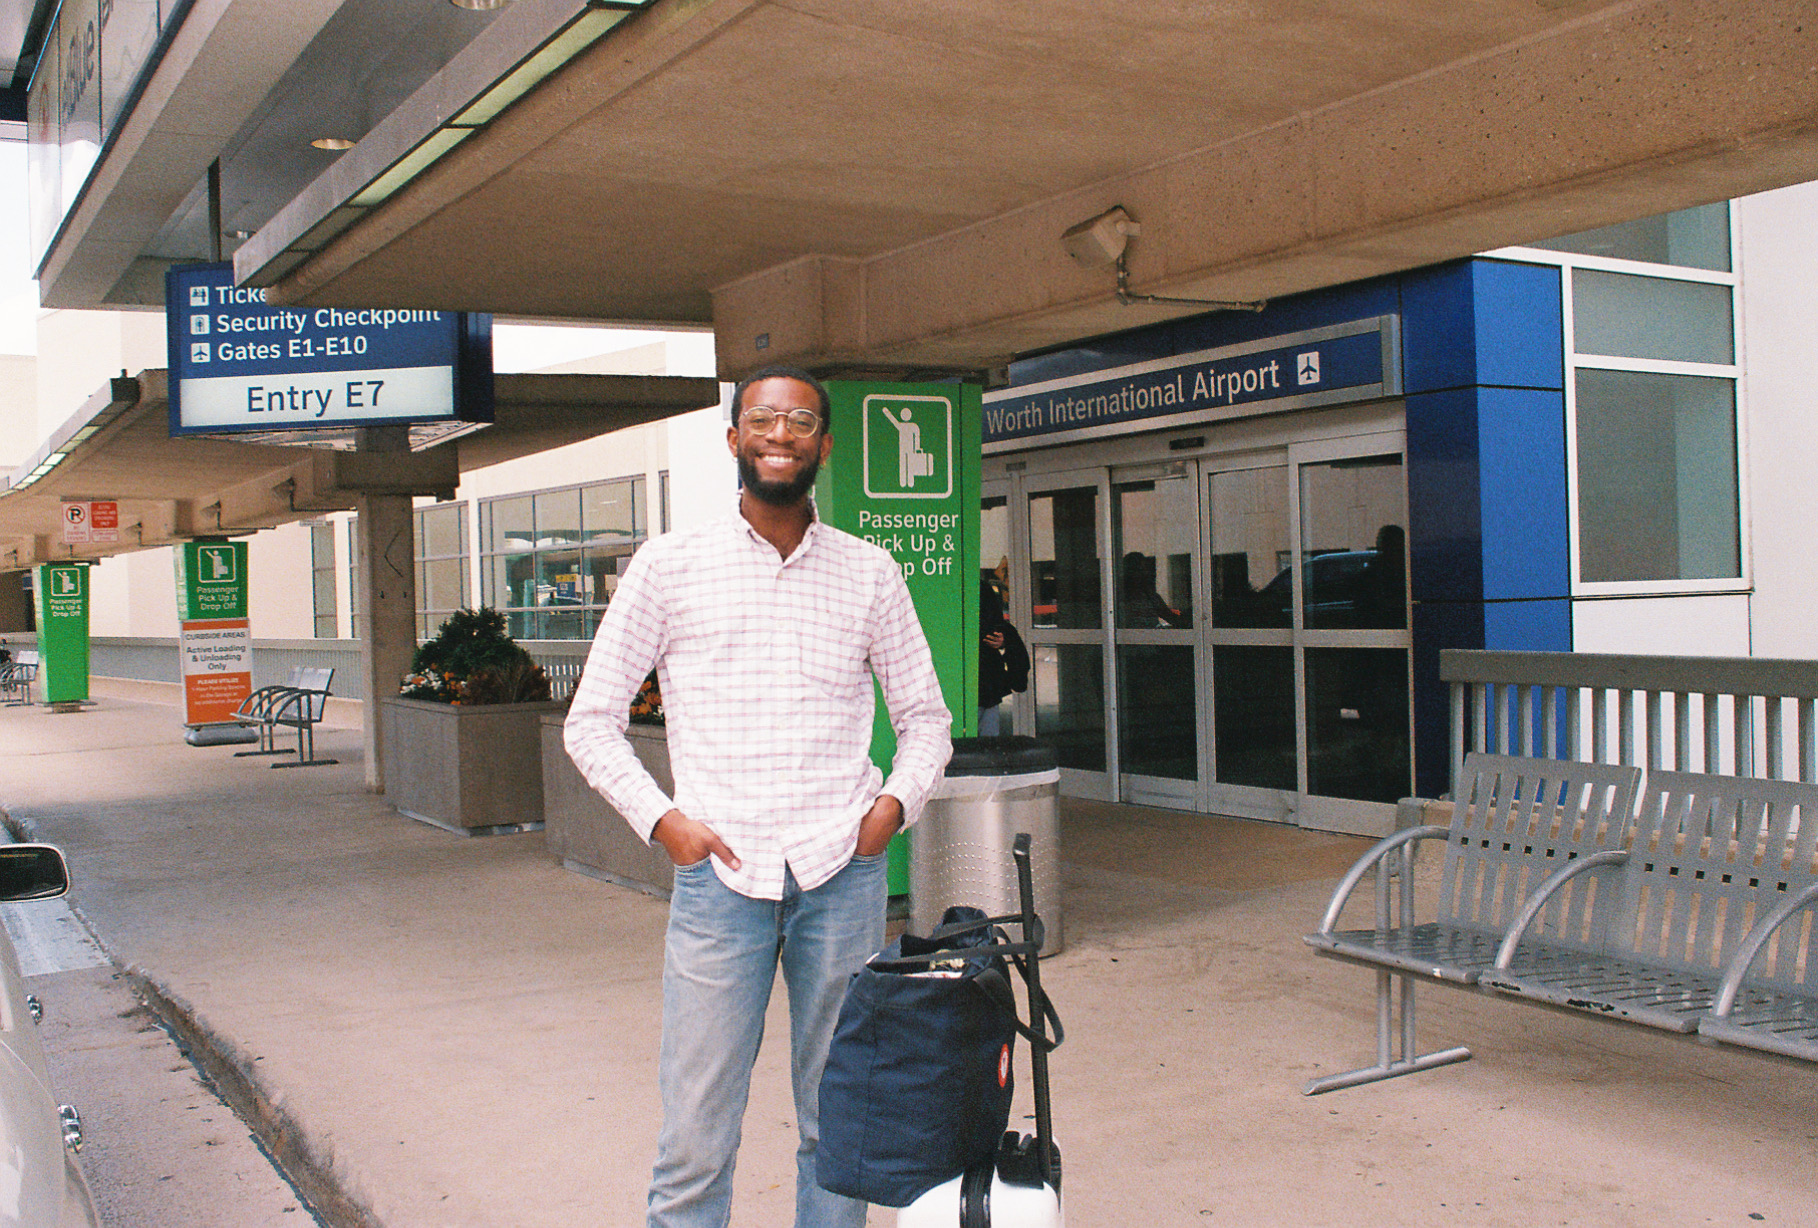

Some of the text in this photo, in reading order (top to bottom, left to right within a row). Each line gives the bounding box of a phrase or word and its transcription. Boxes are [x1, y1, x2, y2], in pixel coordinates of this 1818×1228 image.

[217, 308, 441, 334] Security Checkpoint
[218, 335, 368, 361] Gates E1-E10
[248, 380, 385, 417] Entry E7
[986, 360, 1280, 434] Worth International Airport
[859, 510, 959, 533] Passenger
[911, 534, 936, 557] Up
[942, 534, 955, 551] &
[922, 557, 952, 575] Off
[196, 586, 239, 594] Passenger
[199, 593, 238, 602] Pick Up &
[200, 602, 237, 611] Drop Off
[222, 631, 246, 639] AREAS
[213, 645, 246, 653] Loading
[192, 654, 242, 662] & Unloading
[207, 662, 227, 671] Only
